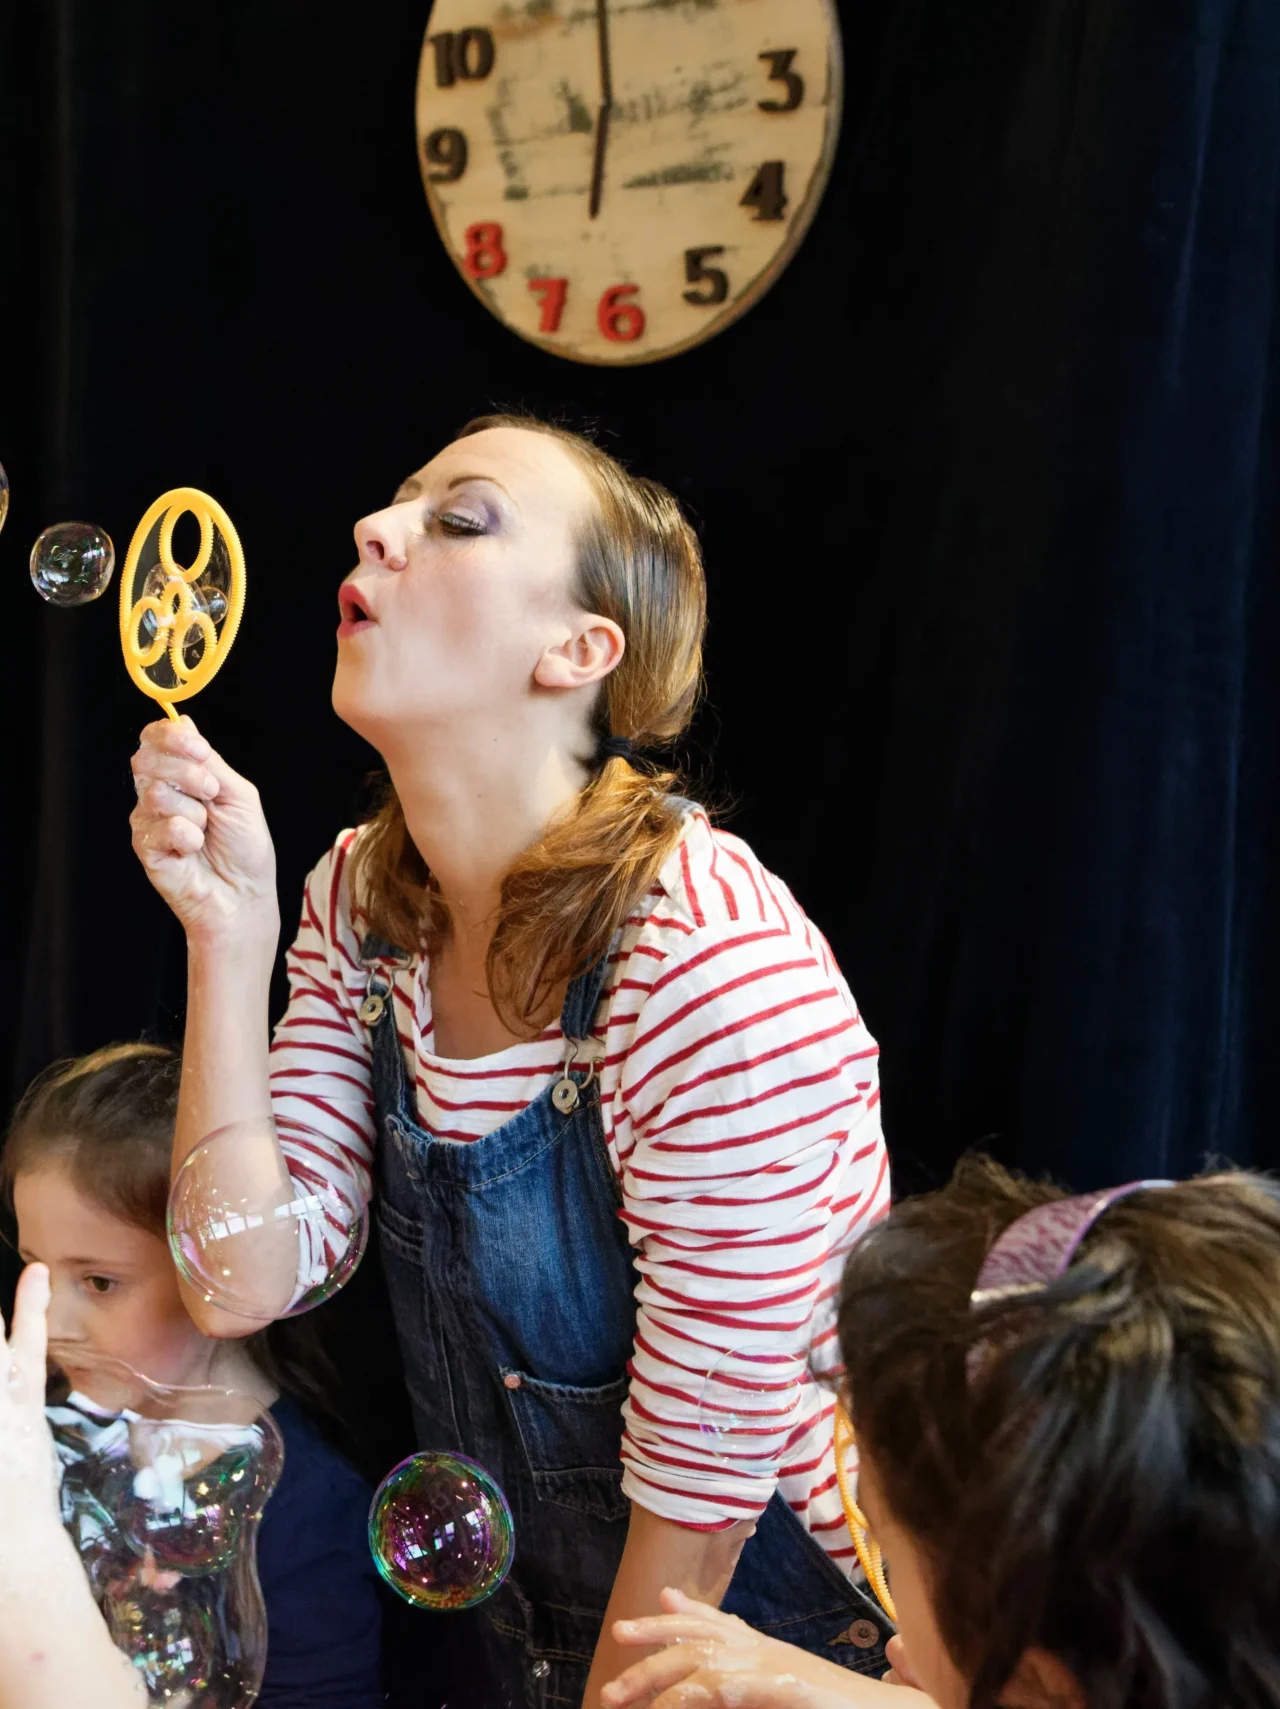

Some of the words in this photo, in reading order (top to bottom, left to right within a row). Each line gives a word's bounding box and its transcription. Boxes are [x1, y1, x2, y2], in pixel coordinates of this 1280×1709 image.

[429, 27, 495, 88] 10
[757, 48, 805, 113] 3
[425, 127, 468, 183] 9
[739, 160, 788, 221] 4
[464, 222, 508, 278] 8
[683, 246, 729, 305] 5
[528, 278, 568, 333] 7
[597, 284, 646, 342] 6
